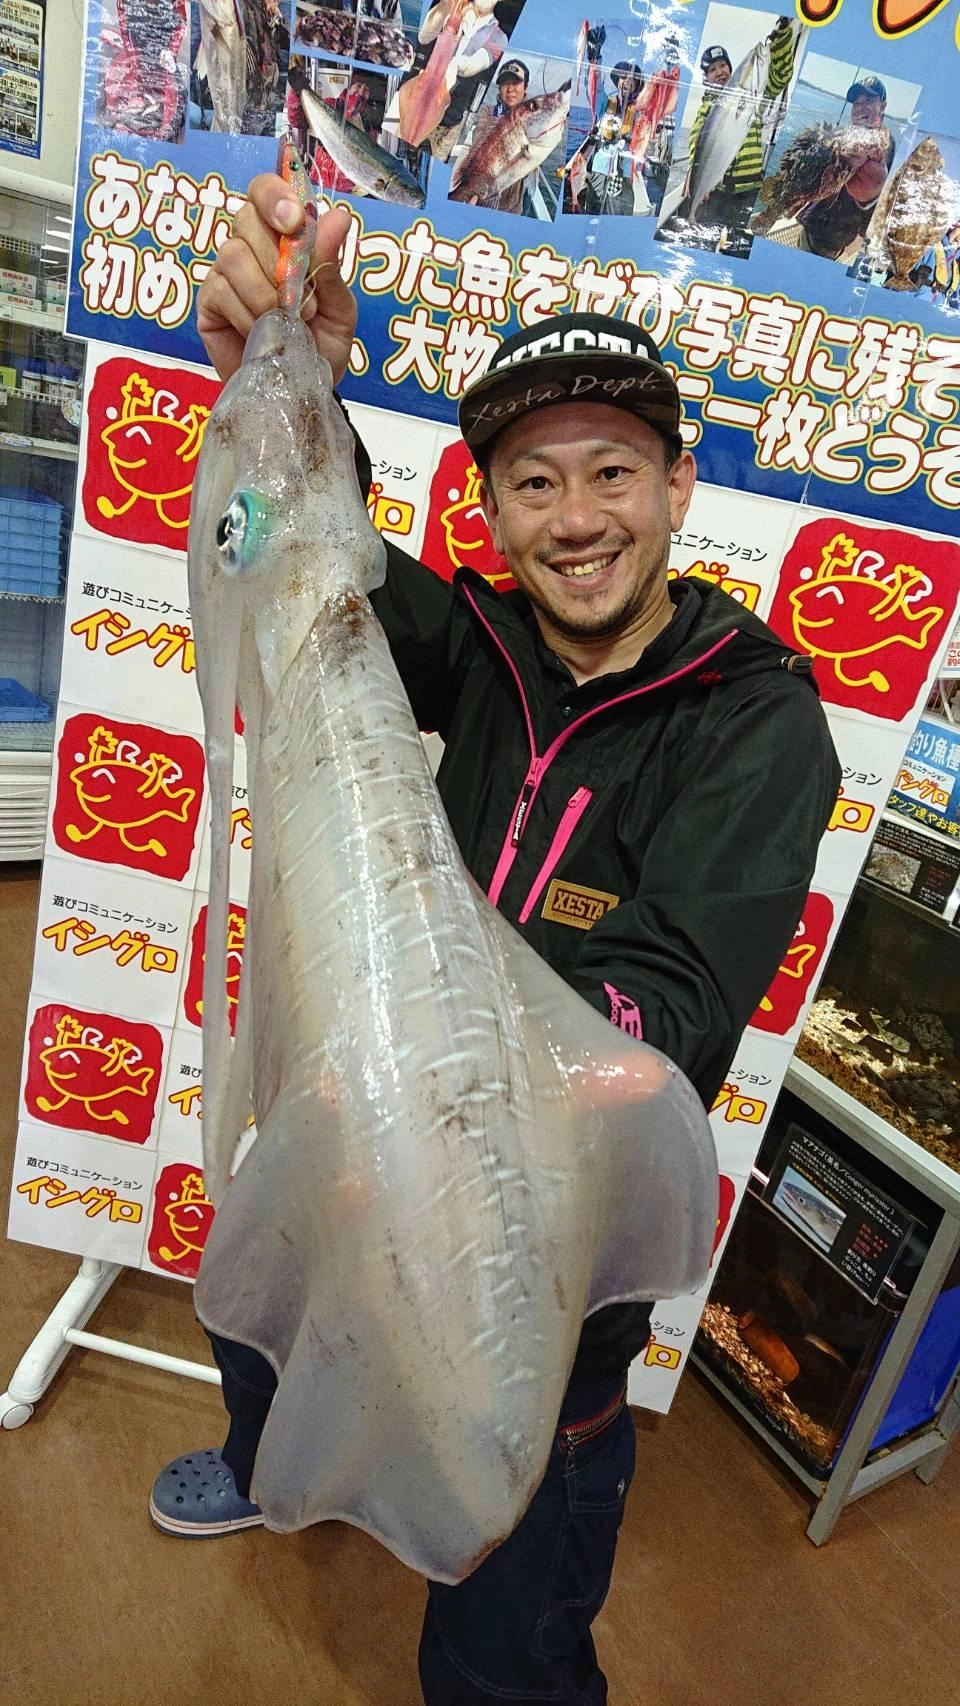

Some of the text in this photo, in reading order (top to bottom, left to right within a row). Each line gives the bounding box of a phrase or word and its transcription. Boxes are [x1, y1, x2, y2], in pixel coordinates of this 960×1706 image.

[467, 371, 663, 436] Xesta Dept.
[512, 801, 527, 841] XESTA
[888, 795, 960, 837] タッフ達やお客
[52, 894, 178, 934] 遊びコミュニケーション
[552, 890, 605, 921] XESTA
[42, 917, 179, 974] イシグロ
[26, 1156, 143, 1190] 遊びコミュニケーション
[16, 1175, 143, 1224] イシグロ
[650, 1320, 685, 1336] ション
